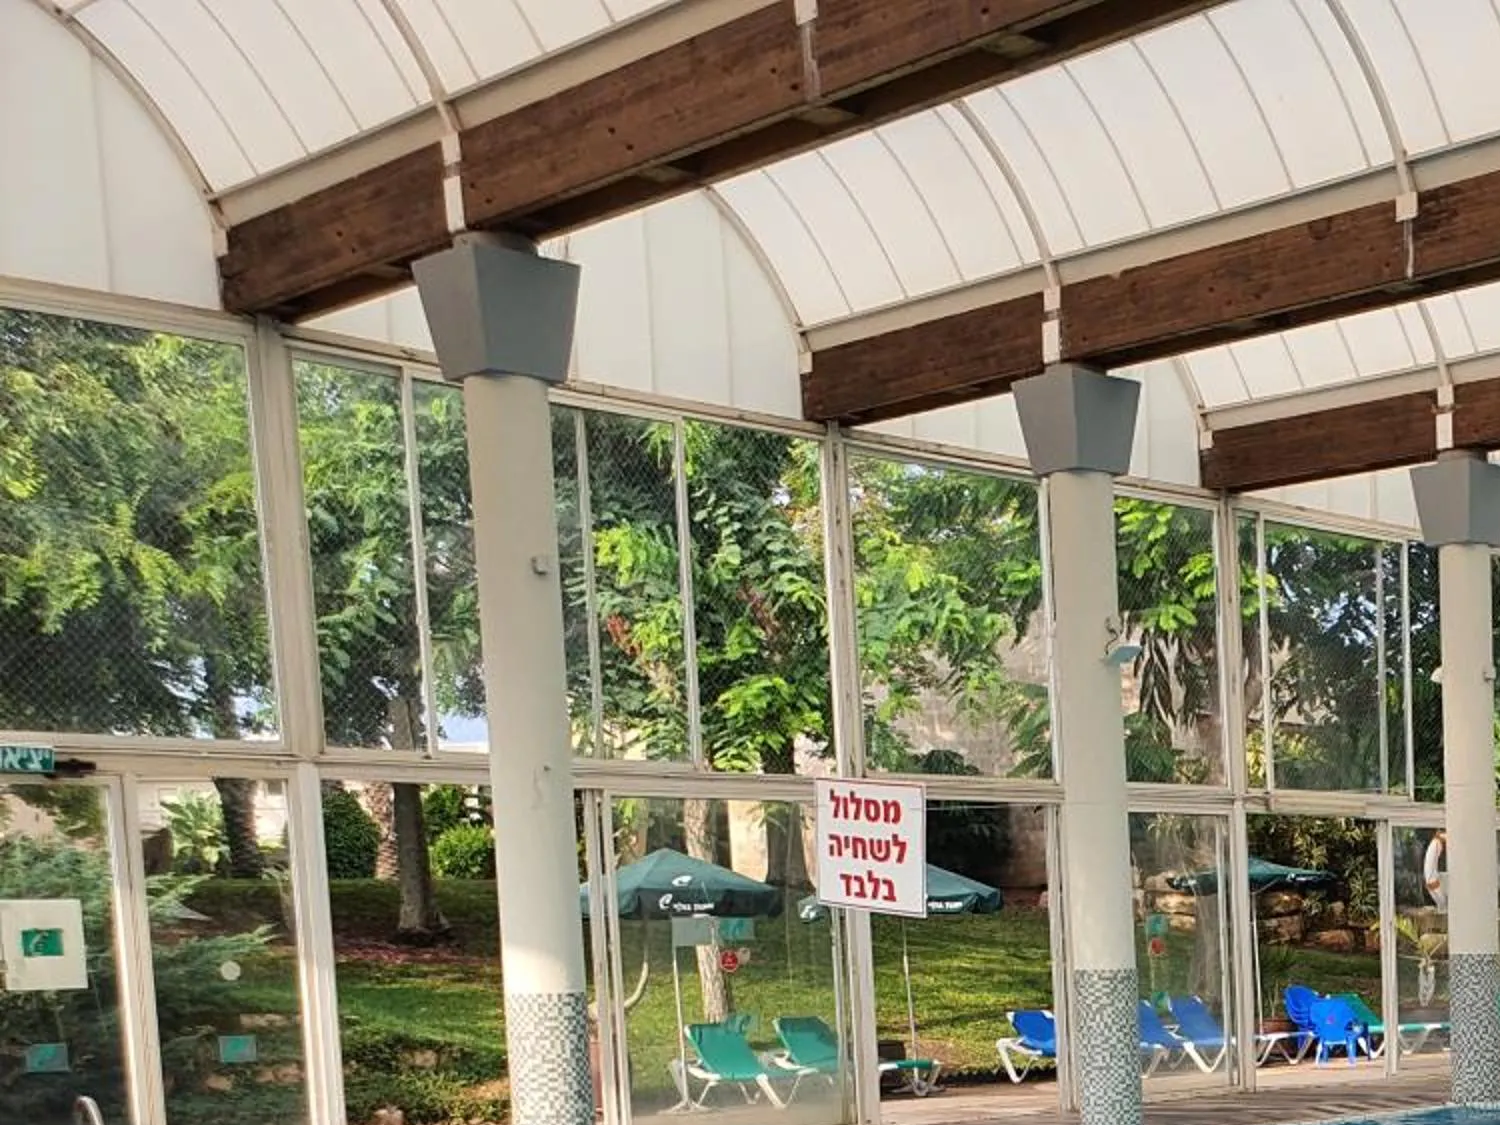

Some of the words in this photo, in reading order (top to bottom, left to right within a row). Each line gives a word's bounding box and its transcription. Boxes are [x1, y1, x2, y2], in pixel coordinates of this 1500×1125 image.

[0, 748, 49, 769] יציא
[829, 788, 903, 825] מסלול
[828, 833, 908, 864] לשחיה
[839, 870, 897, 902] בלבד
